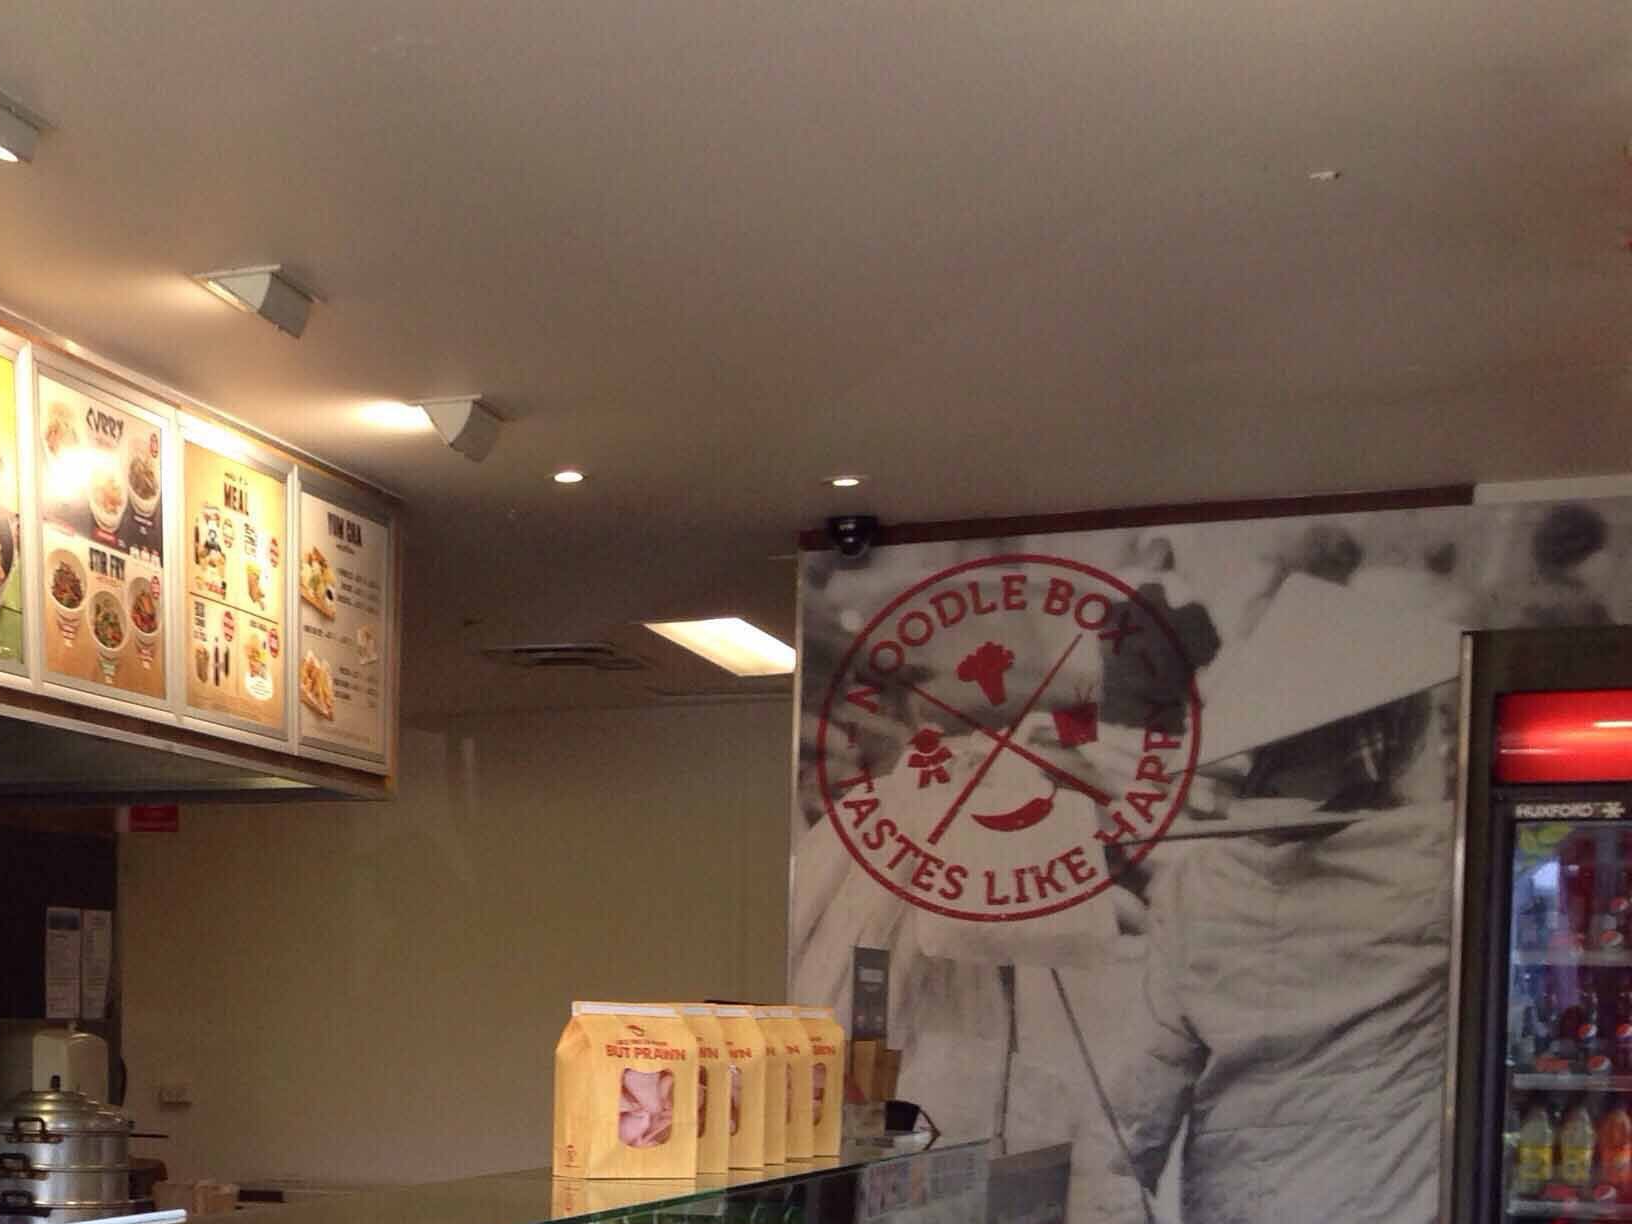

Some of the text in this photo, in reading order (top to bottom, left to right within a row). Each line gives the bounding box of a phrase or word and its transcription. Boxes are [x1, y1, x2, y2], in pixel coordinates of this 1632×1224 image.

[223, 481, 249, 517] MEAL
[847, 574, 1140, 714] NOODLE BOX
[838, 727, 1183, 907] TASTES LIKE HAPP
[633, 1046, 686, 1062] PRAWN
